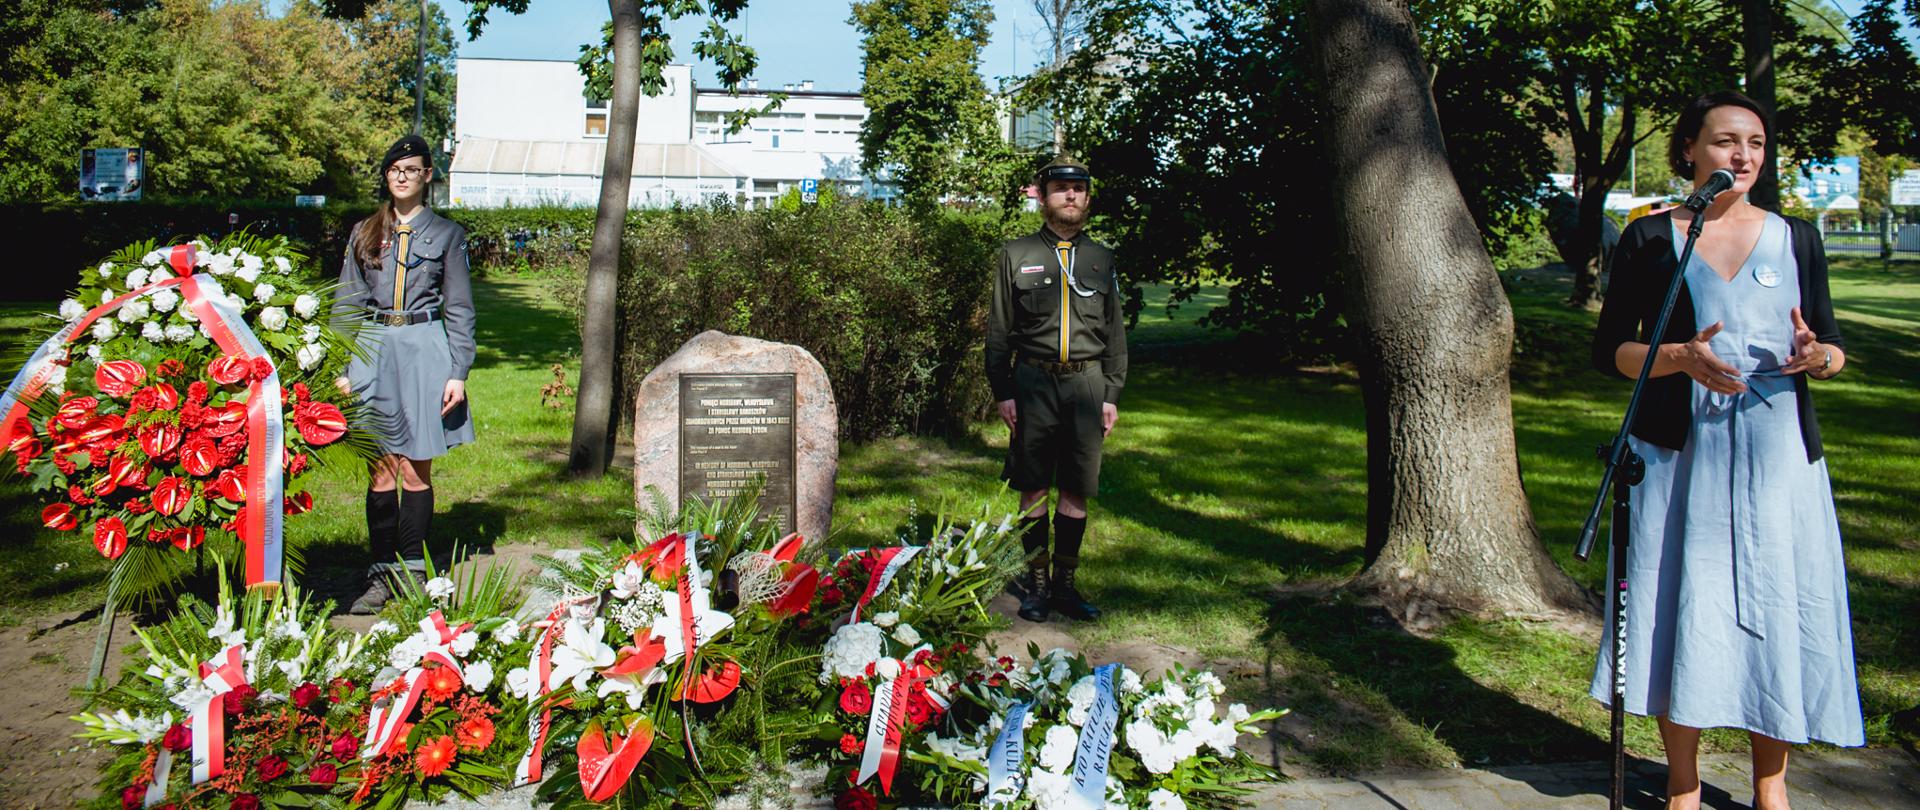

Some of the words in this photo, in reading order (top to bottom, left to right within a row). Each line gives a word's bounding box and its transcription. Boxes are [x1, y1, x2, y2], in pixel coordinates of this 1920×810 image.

[805, 180, 814, 191] P
[1081, 697, 1107, 753] RATUJE
[1094, 716, 1113, 775] RATUJE
[1075, 755, 1088, 788] KTO
